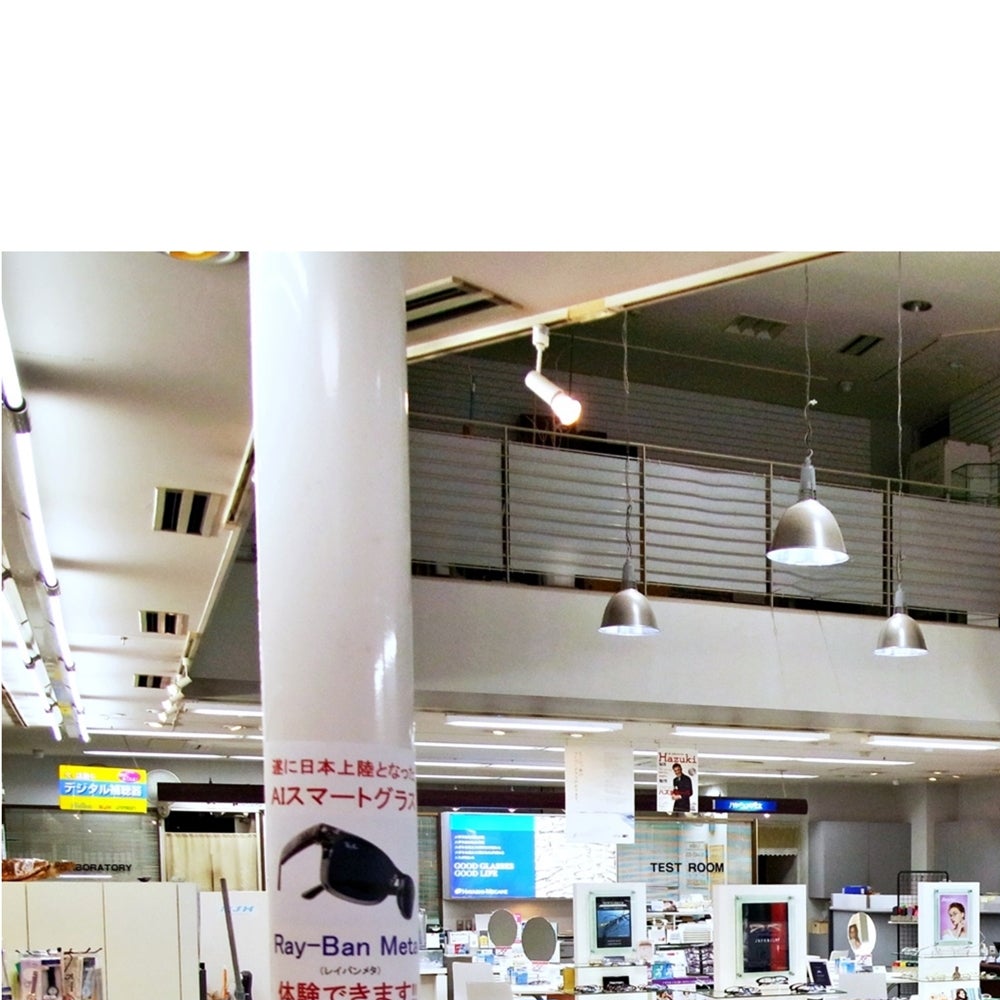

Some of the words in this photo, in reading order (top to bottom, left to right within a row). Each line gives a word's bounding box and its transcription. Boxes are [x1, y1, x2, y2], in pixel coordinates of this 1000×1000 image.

[658, 752, 697, 764] Hazuki
[453, 862, 478, 870] GOOD
[650, 862, 682, 873] TEST
[688, 862, 724, 873] ROOM
[453, 869, 479, 877] GOOD
[274, 934, 371, 959] Ray-Ban
